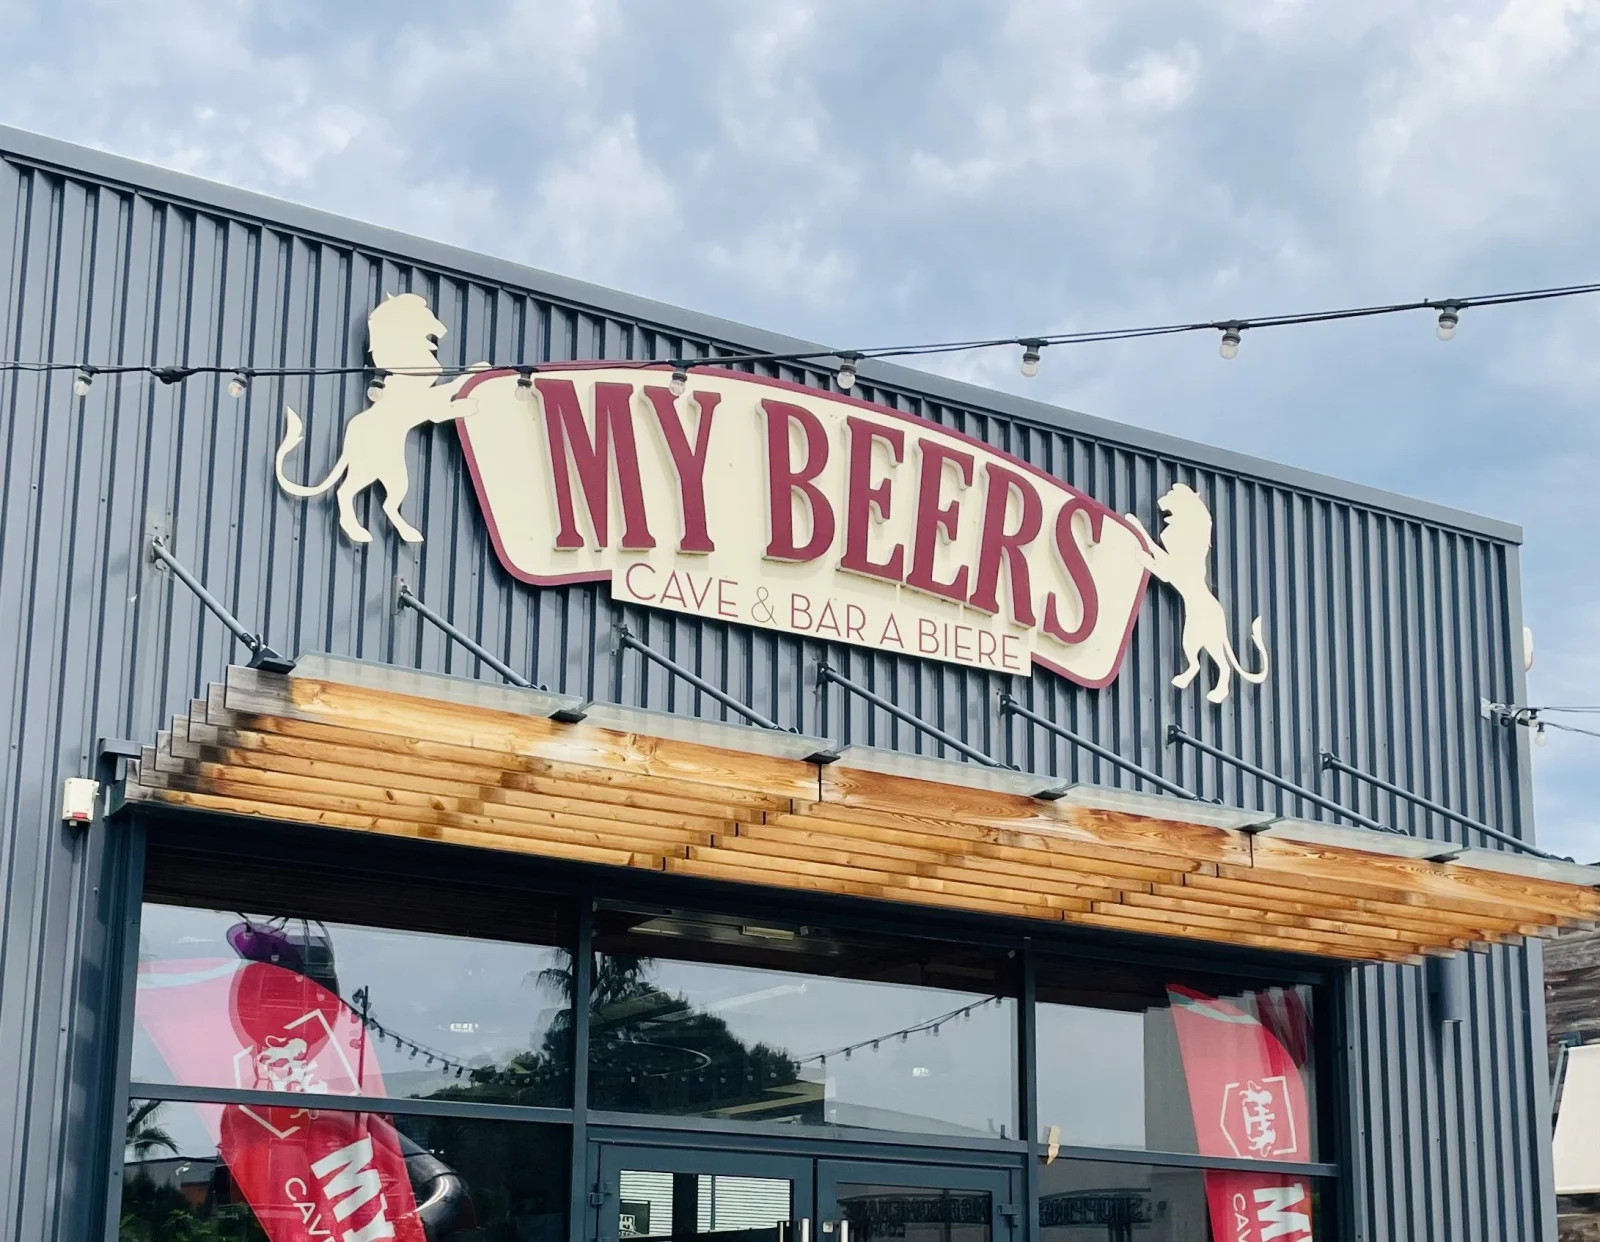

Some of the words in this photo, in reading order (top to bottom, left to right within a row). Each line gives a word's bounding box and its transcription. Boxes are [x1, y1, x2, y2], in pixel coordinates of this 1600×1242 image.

[532, 377, 722, 553] MY
[758, 397, 1104, 645] BEERS
[625, 562, 739, 618] CAVE
[750, 586, 777, 625] &
[791, 593, 866, 642] BAR
[879, 612, 904, 649] A
[918, 617, 1021, 670] BIERE
